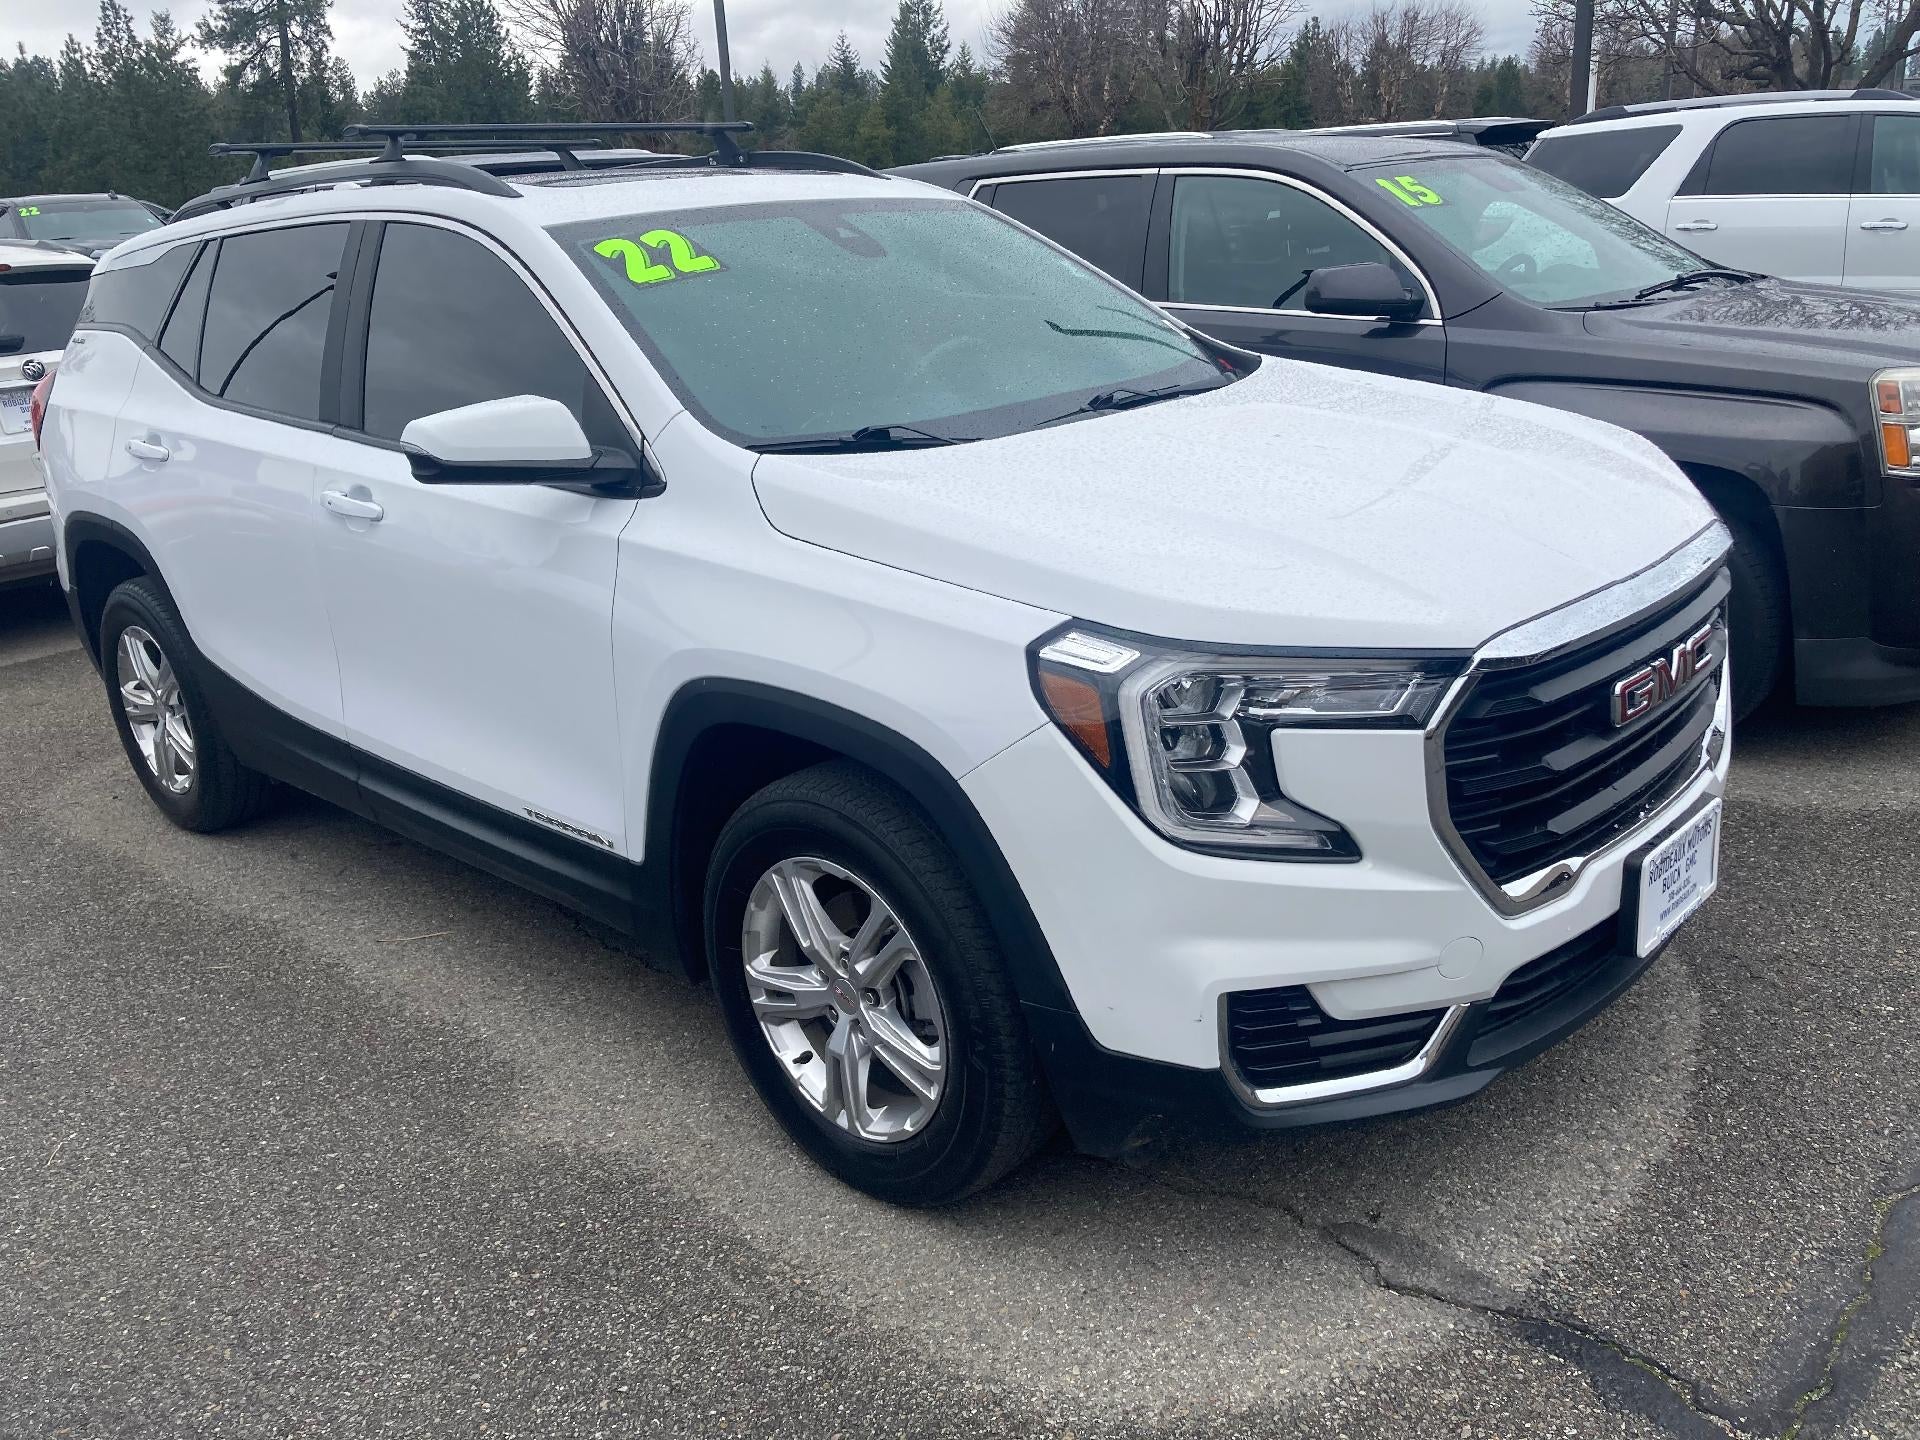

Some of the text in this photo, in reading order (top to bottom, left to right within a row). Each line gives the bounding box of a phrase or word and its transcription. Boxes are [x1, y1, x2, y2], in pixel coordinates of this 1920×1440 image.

[18, 206, 40, 217] 22
[1375, 175, 1443, 207] 15
[593, 229, 721, 284] 22
[1610, 623, 1713, 728] GMC
[522, 805, 614, 849] TERRAIN
[1662, 850, 1698, 894] BUICK GMC
